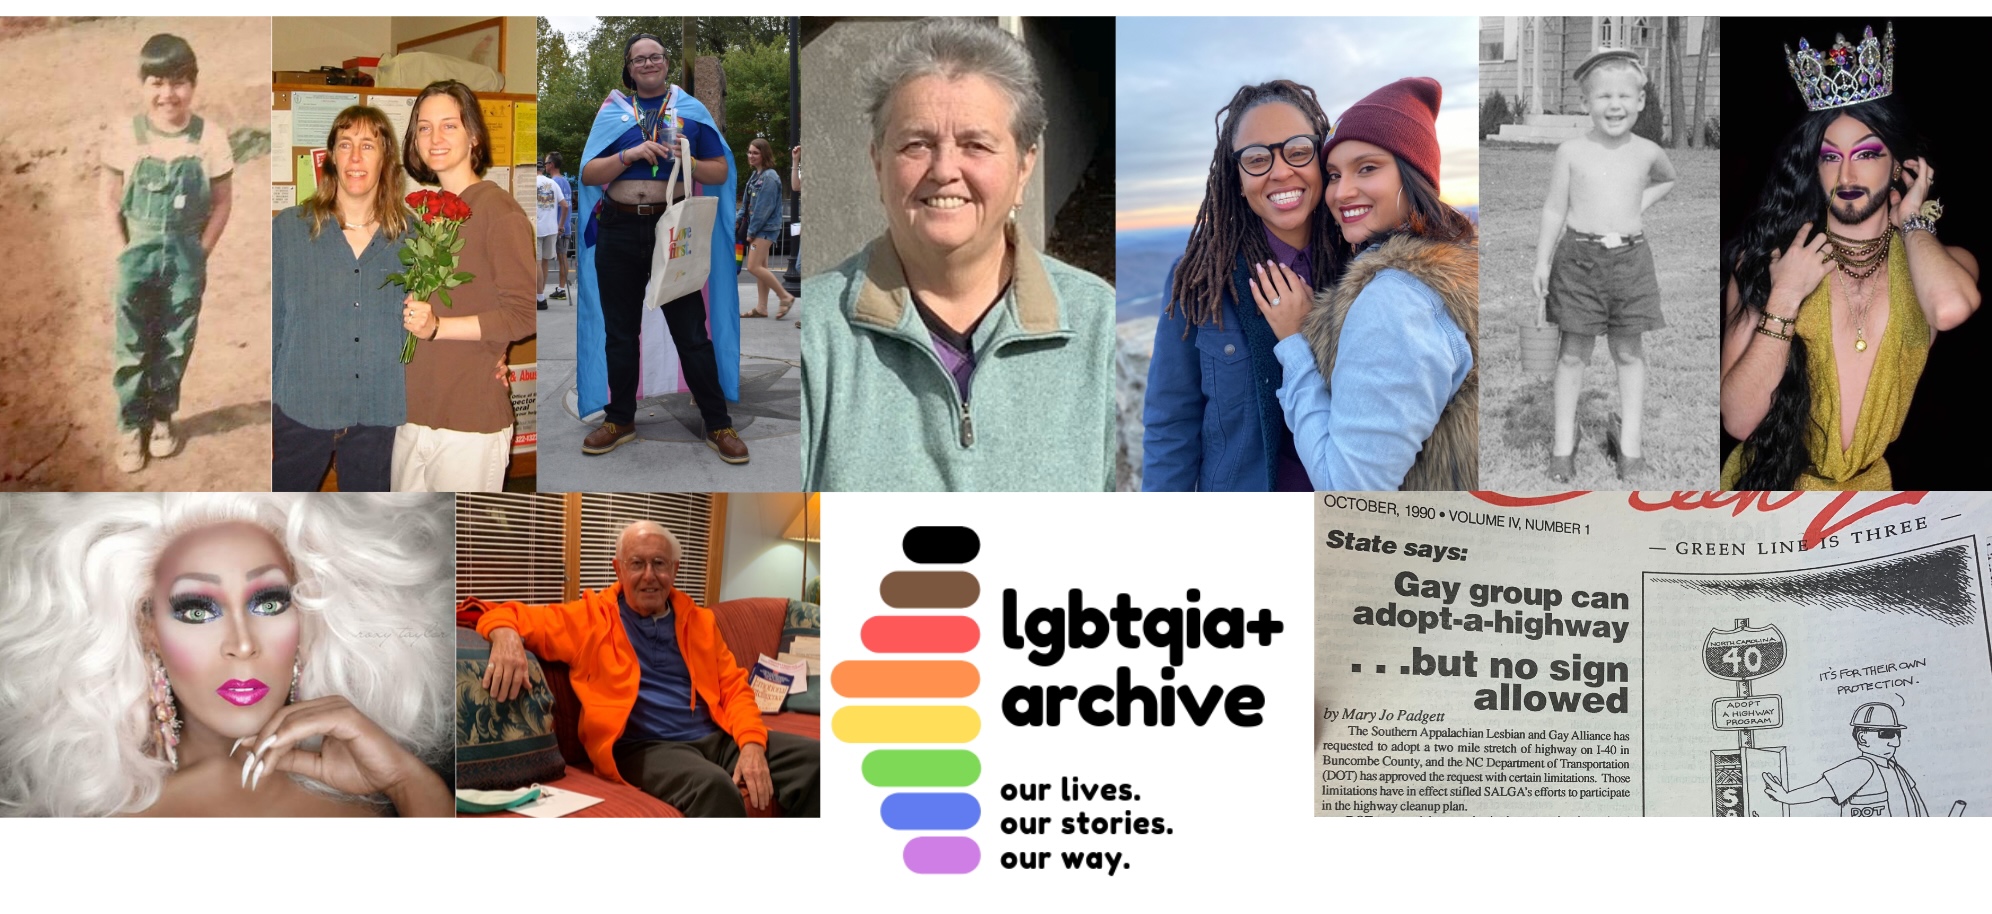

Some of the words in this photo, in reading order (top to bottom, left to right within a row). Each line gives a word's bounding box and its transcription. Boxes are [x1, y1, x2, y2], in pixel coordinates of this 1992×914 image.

[669, 226, 692, 243] Love
[669, 241, 692, 260] first.
[1324, 494, 1399, 517] OCTOBER,
[1405, 505, 1436, 520] 1990
[1449, 510, 1505, 527] VOLUME
[1509, 517, 1521, 530] IV,
[1525, 518, 1580, 534] NUMBER
[1585, 524, 1589, 535] 1
[1675, 540, 1746, 557] GREEN
[1757, 539, 1809, 556] LINE
[1819, 534, 1841, 550] IS
[1850, 515, 1928, 545] THREE
[1326, 530, 1397, 554] State
[1403, 543, 1468, 562] says:
[1394, 571, 1461, 605] Gay
[1469, 584, 1562, 611] group
[1571, 591, 1629, 610] can
[1353, 602, 1629, 643] adopt-a-highway
[1722, 646, 1762, 674] 40
[1490, 658, 1538, 680] no
[1549, 653, 1628, 688] sign
[1819, 666, 1837, 681] IT'S
[1840, 668, 1861, 679] FOR
[1862, 663, 1898, 676] THEIR
[1898, 658, 1926, 670] OWN
[1837, 676, 1919, 694] PROTECTION.
[1474, 683, 1628, 714] allowed
[1726, 700, 1760, 708] ADOPT
[1323, 707, 1339, 722] by
[1341, 708, 1376, 723] Mary
[1378, 709, 1394, 721] Jo
[1397, 710, 1445, 724] Padgett
[1726, 718, 1772, 726] PROGRAM
[1732, 709, 1774, 718] HIGHWAY
[1347, 725, 1368, 736] The
[1371, 726, 1417, 737] Southern
[1420, 727, 1484, 740] Appalachian
[1486, 729, 1525, 739] Lesbian
[1528, 730, 1546, 740] and
[1548, 730, 1569, 742] Gay
[1571, 731, 1611, 741] Alliance
[1614, 731, 1630, 741] has
[1323, 741, 1373, 753] requested
[1378, 743, 1388, 751] to
[1391, 741, 1420, 754] adopt
[1424, 744, 1430, 752] a
[1434, 744, 1454, 752] two
[1458, 742, 1480, 753] mile
[1484, 743, 1517, 753] stretch
[1521, 744, 1532, 753] of
[1535, 744, 1577, 757] highway
[1597, 745, 1617, 755] I-40
[1620, 745, 1629, 754] in
[1322, 755, 1380, 766] Buncombe
[1382, 756, 1423, 769] County,
[1425, 757, 1444, 767] and
[1447, 757, 1463, 767] the
[1466, 757, 1483, 767] NC
[1486, 758, 1545, 770] Department
[1547, 758, 1558, 768] of
[1559, 759, 1629, 771] Transportation
[1322, 770, 1358, 783] (DOT)
[1360, 771, 1377, 781] has
[1379, 771, 1426, 784] approved
[1429, 772, 1444, 781] the
[1446, 774, 1483, 784] request
[1485, 772, 1507, 782] with
[1509, 772, 1541, 782] certain
[1544, 773, 1597, 783] limitations.
[1601, 773, 1631, 783] Those
[1322, 785, 1377, 796] limitations
[1380, 786, 1404, 796] have
[1406, 786, 1416, 796] in
[1419, 786, 1448, 796] effect
[1450, 786, 1481, 796] stifled
[1484, 786, 1532, 797] SALGA's
[1534, 787, 1566, 797] efforts
[1568, 789, 1578, 797] to
[1580, 787, 1630, 800] participate
[1322, 800, 1332, 810] in
[1335, 800, 1351, 811] the
[1353, 800, 1398, 814] highway
[1400, 801, 1441, 814] cleanup
[1442, 801, 1468, 814] plan.
[1850, 806, 1886, 817] DOT
